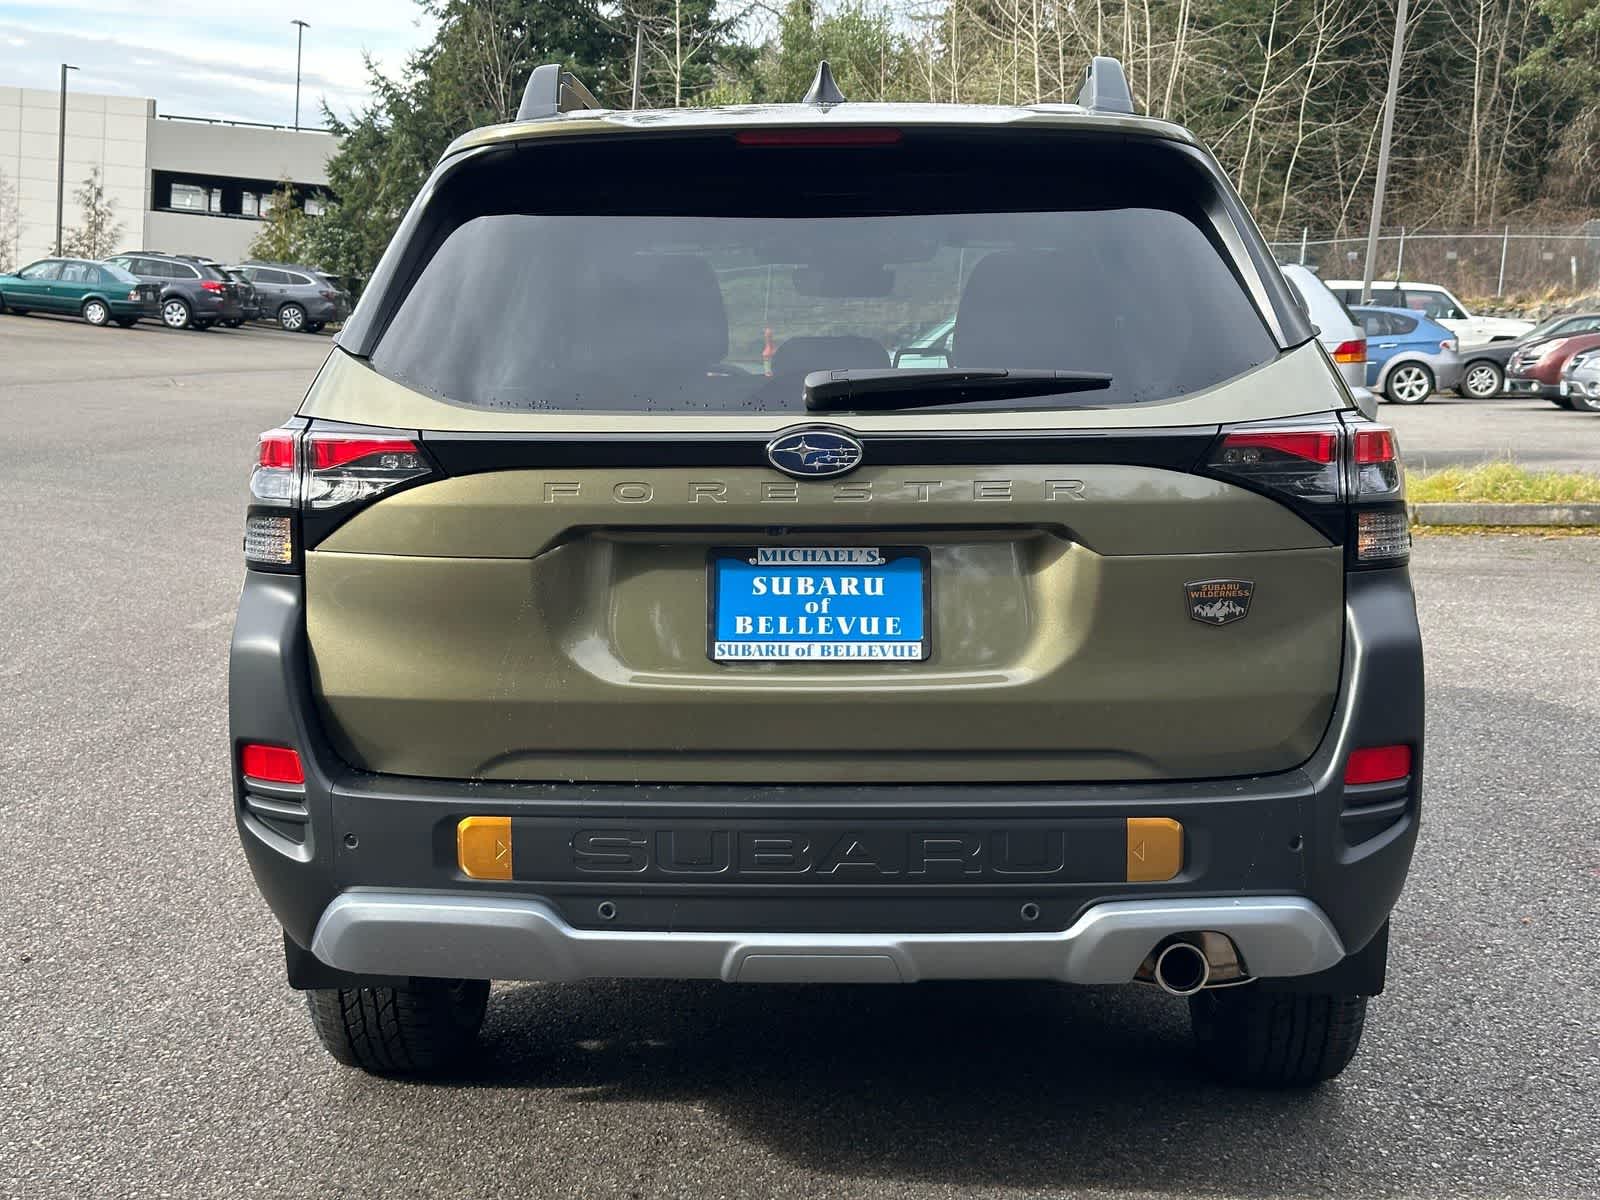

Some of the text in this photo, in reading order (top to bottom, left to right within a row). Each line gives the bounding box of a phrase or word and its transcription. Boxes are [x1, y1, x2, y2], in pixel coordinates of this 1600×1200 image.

[543, 480, 1088, 503] FORESTER
[759, 549, 878, 562] MICHAEL'S
[752, 576, 885, 596] SUBARU
[1190, 590, 1250, 598] WILDERNESS
[1201, 583, 1240, 591] SUBARU
[804, 598, 831, 614] of
[735, 616, 902, 634] BELLEVUE
[716, 643, 919, 658] SUBARU of BELLEVUE
[571, 829, 1066, 875] SUBARU
